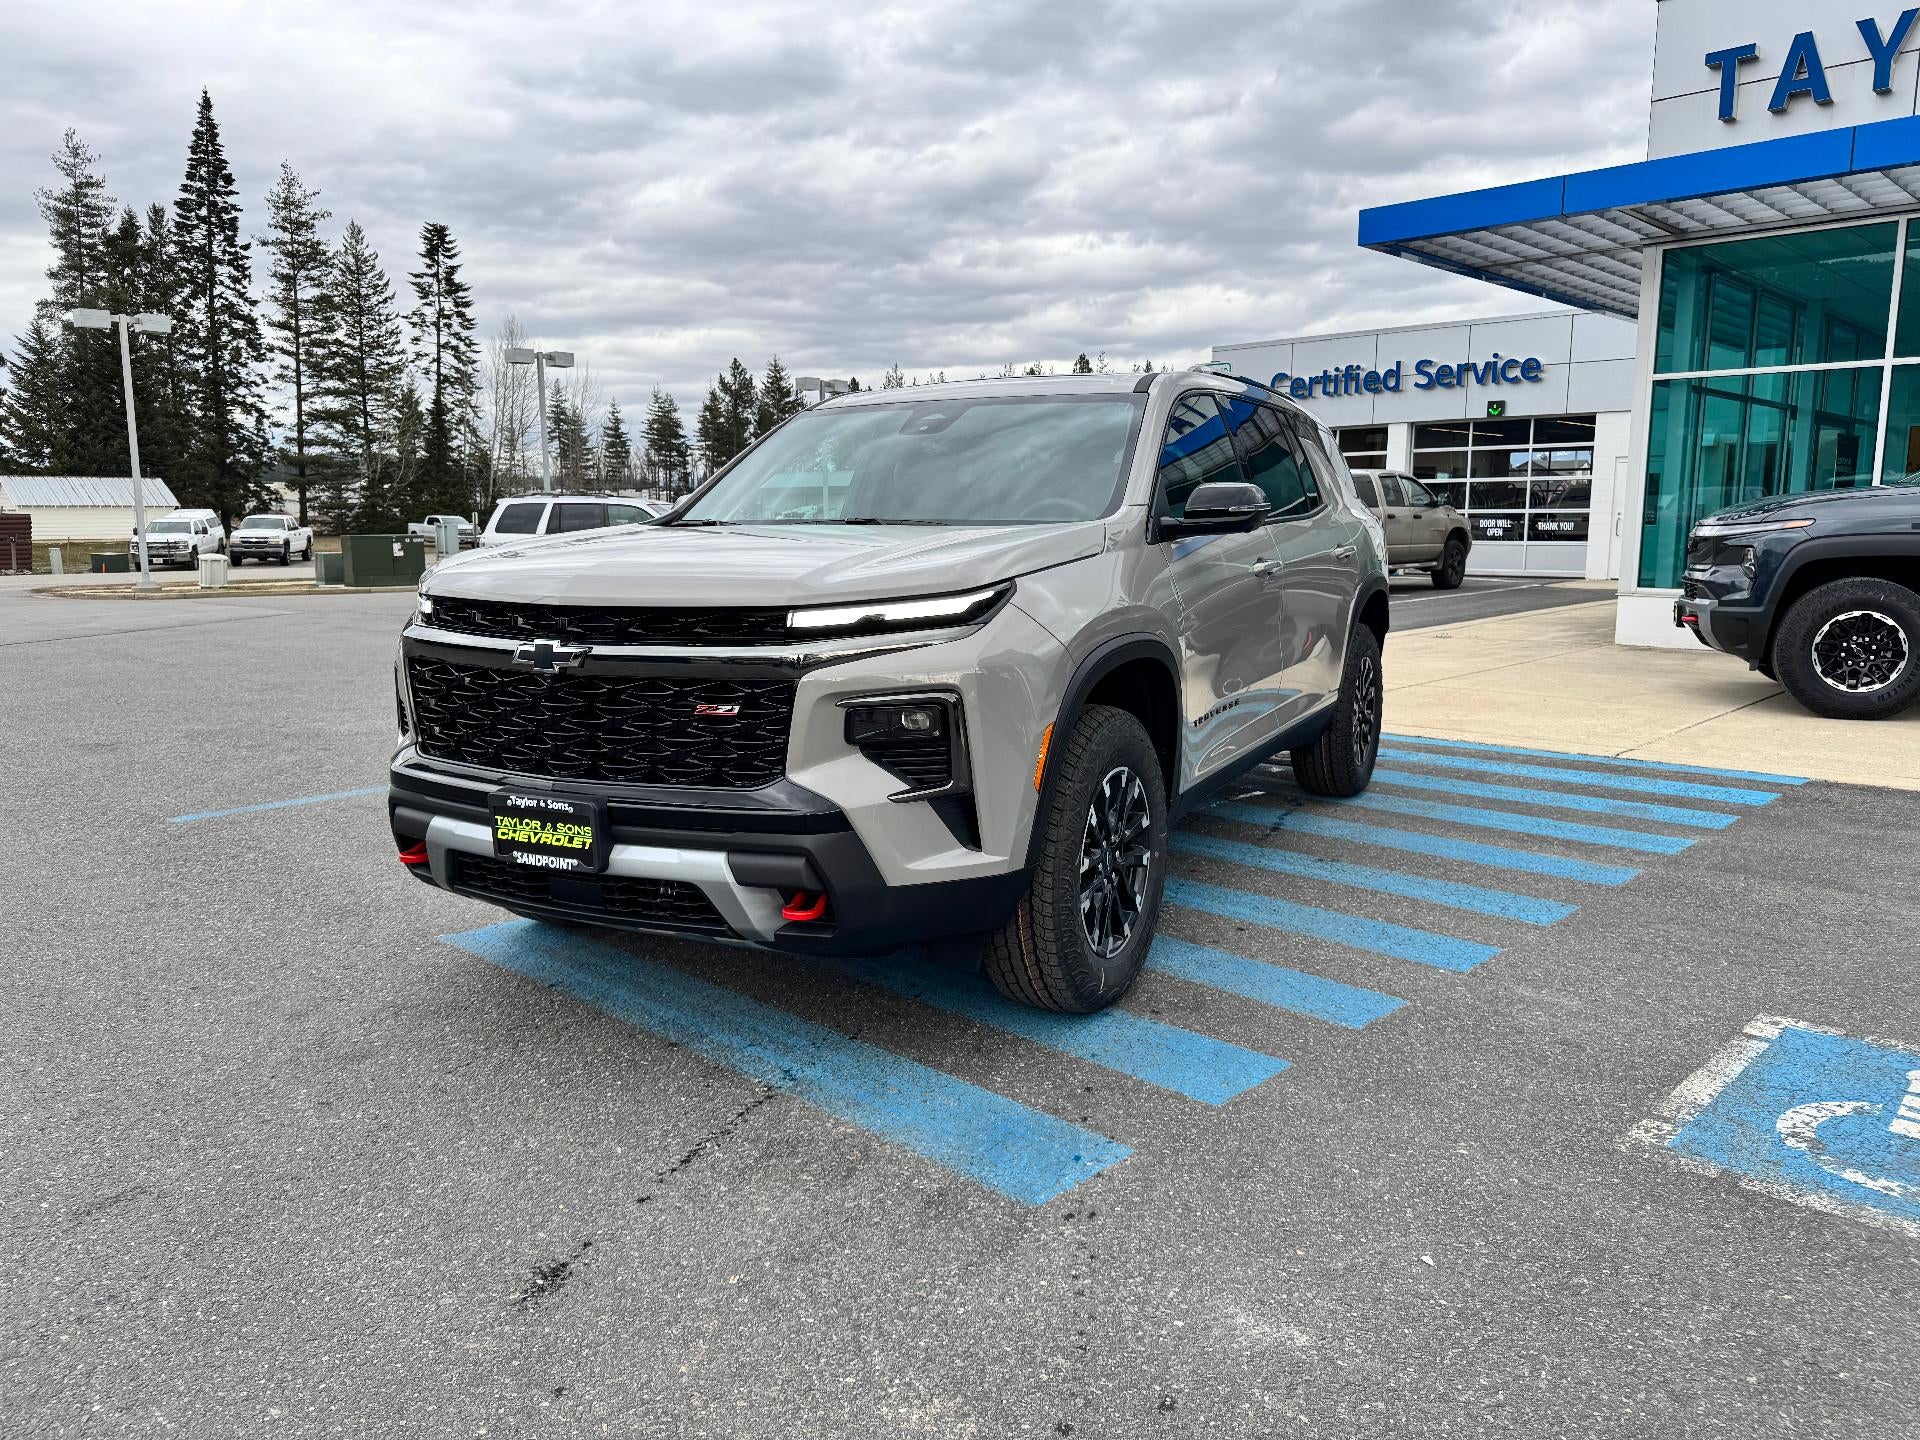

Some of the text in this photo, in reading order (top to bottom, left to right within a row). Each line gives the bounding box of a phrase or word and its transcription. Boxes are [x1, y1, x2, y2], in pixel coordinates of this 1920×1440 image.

[1704, 7, 1920, 123] TAY
[1270, 352, 1543, 400] Certified Service
[1479, 519, 1511, 528] DOOR WILL
[1487, 528, 1502, 537] OPEN
[1537, 522, 1574, 531] THANK YOU!
[694, 704, 741, 715] Z71
[1193, 699, 1241, 727] TRAVERSE
[509, 795, 569, 811] Taylor & Sons
[495, 816, 592, 836] TAYLOR & SONS
[497, 828, 592, 850] CHEVROLET
[516, 852, 574, 871] SANDPOINT
